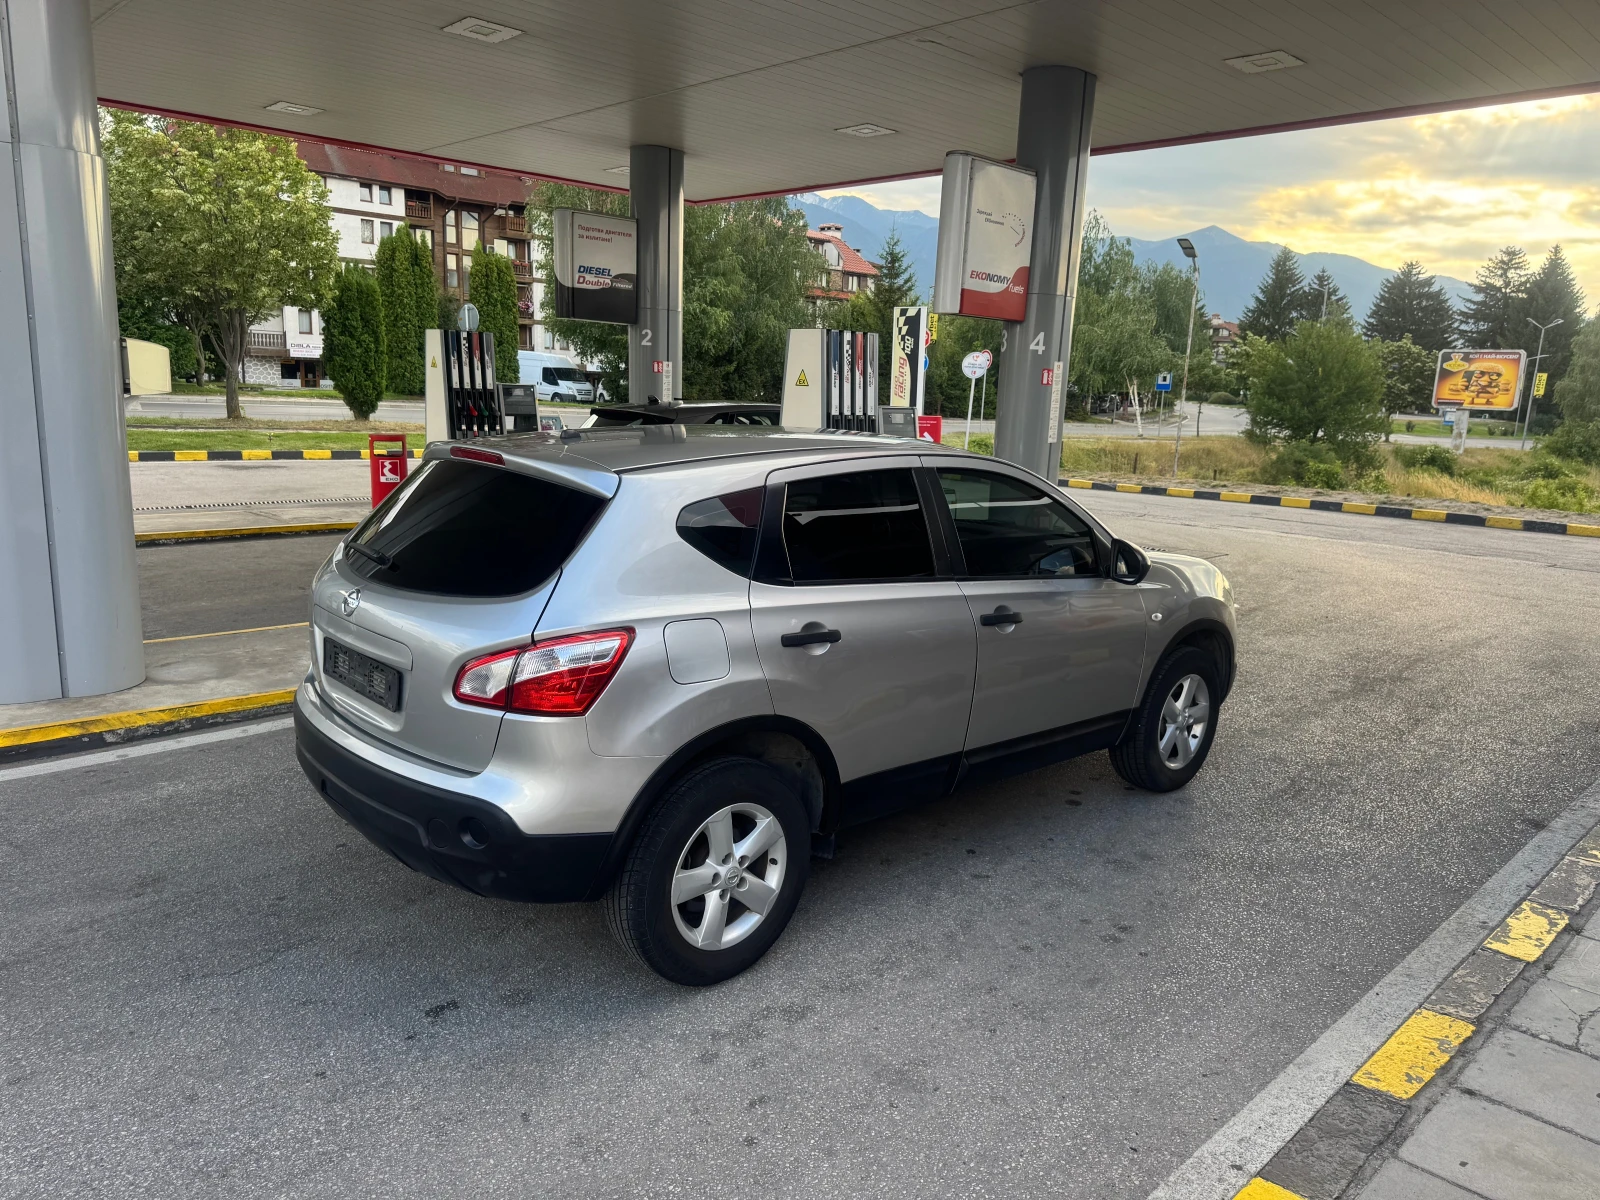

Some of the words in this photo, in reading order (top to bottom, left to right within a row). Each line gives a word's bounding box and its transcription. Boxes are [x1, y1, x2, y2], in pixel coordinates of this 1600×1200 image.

[577, 265, 613, 277] DIESEL
[969, 270, 1011, 286] EKONOMY
[576, 276, 610, 288] Double
[1008, 283, 1025, 294] fuels
[641, 328, 652, 346] 2
[904, 335, 912, 355] 100
[1001, 329, 1008, 353] 3
[1029, 331, 1046, 355] 4
[897, 356, 907, 399] racing
